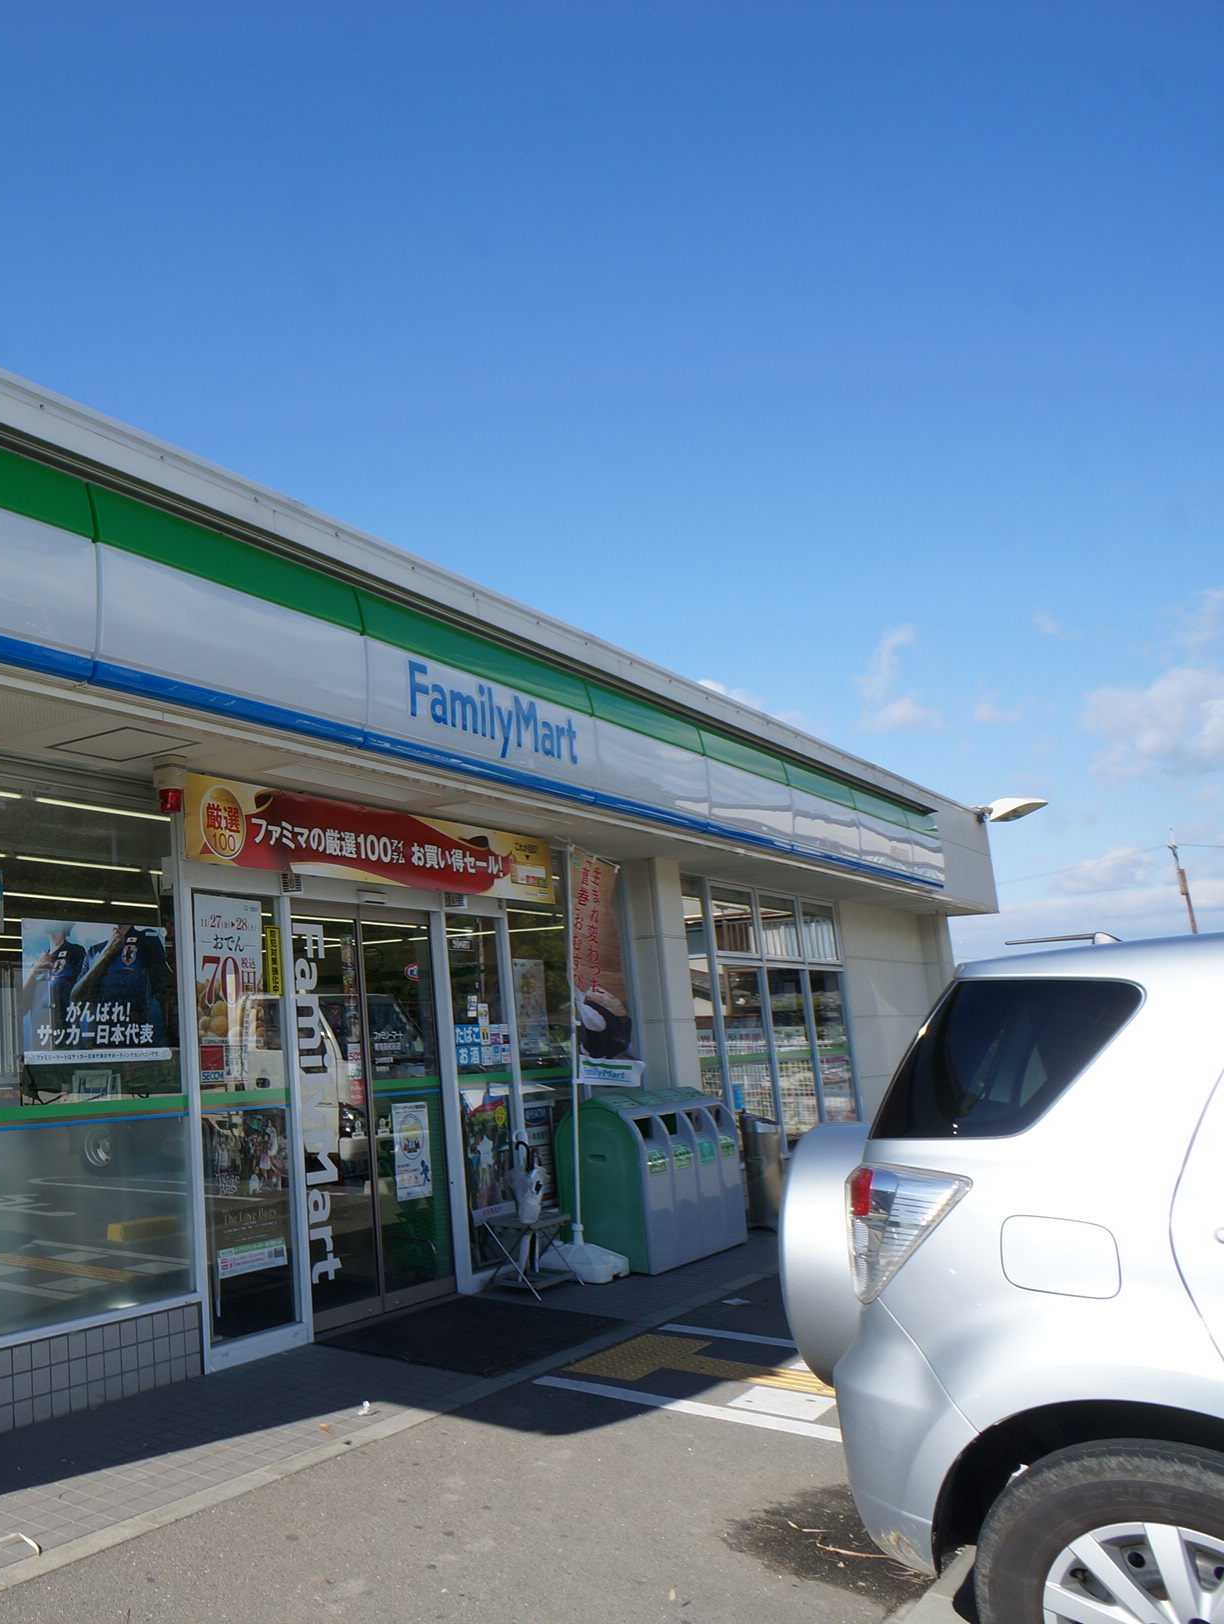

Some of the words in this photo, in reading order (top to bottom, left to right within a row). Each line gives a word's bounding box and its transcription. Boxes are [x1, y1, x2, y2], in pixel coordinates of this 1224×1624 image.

[408, 659, 578, 765] FamilyMart
[206, 802, 241, 833] 厳選
[212, 832, 236, 852] 100
[212, 933, 245, 952] おでん
[64, 1002, 131, 1023] がんばれ!
[36, 1023, 154, 1046] サッカー日本代表
[455, 1026, 481, 1044] たばこ
[459, 1047, 480, 1064] お酒
[291, 923, 343, 1284] FamilyMart
